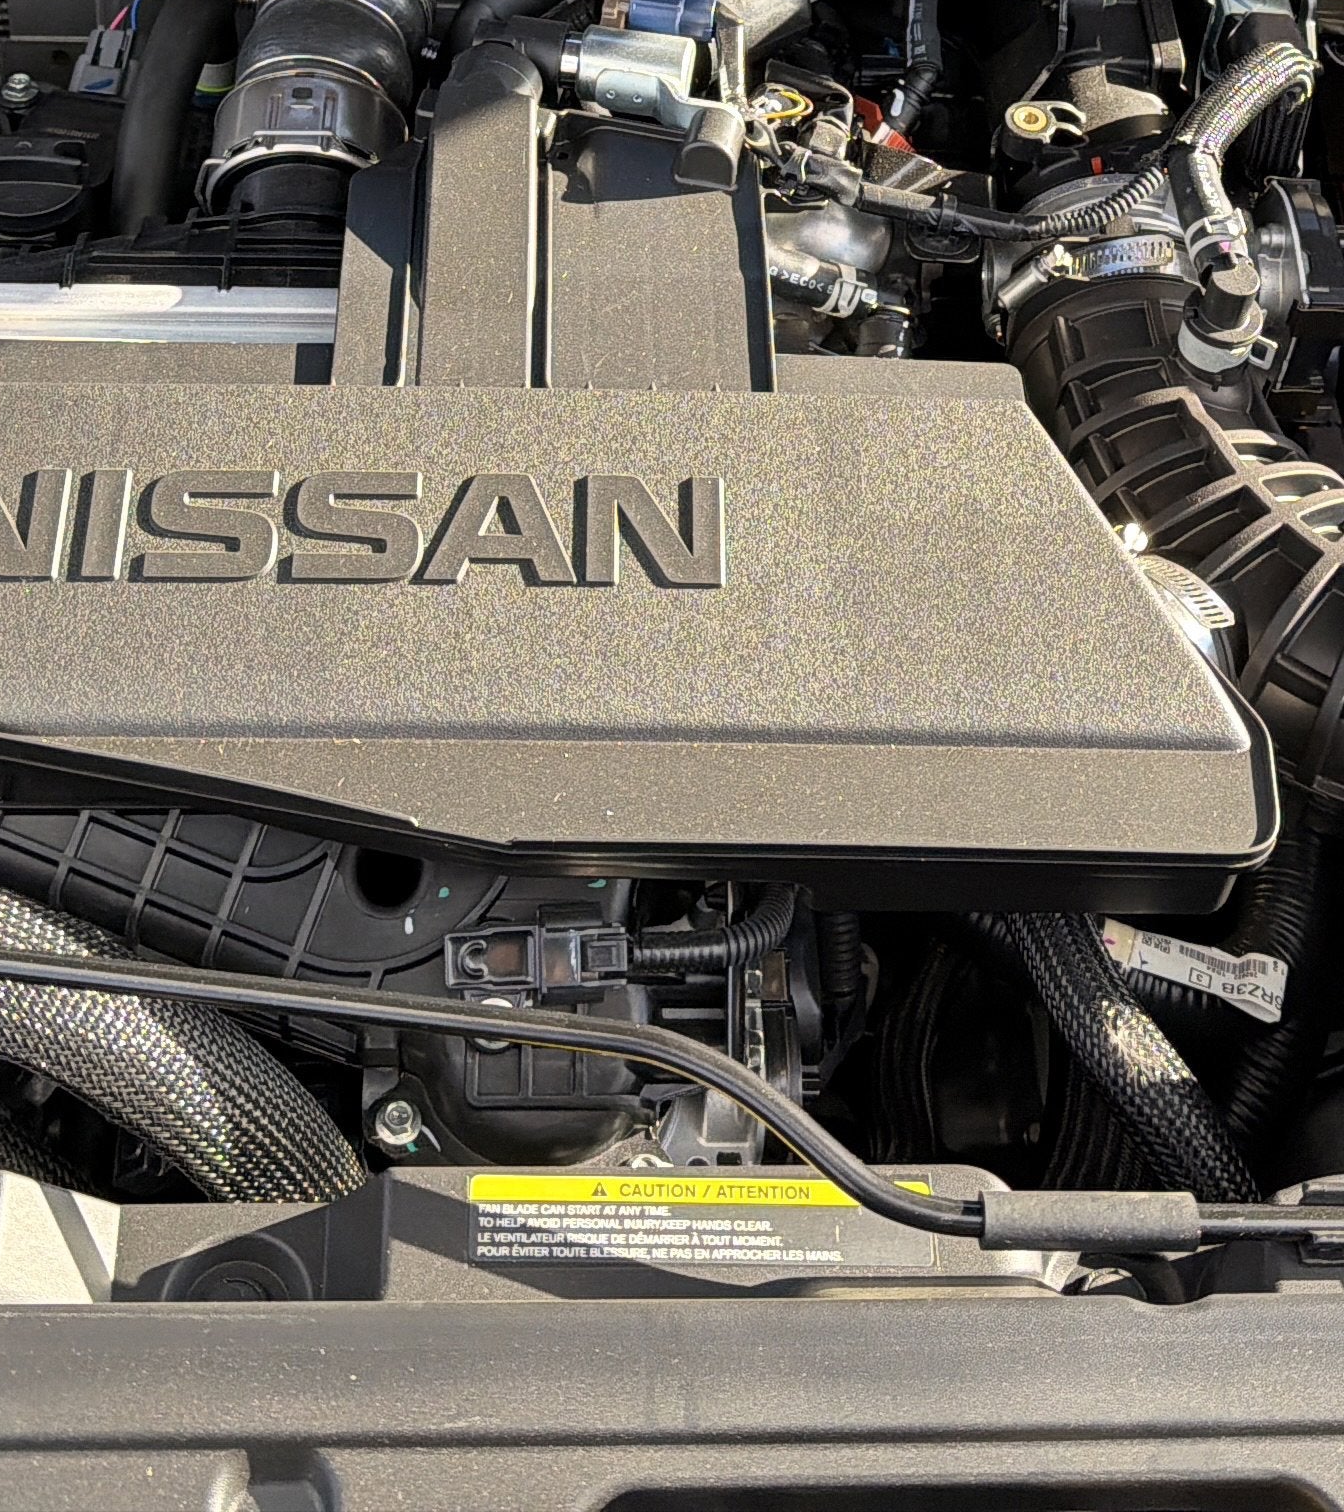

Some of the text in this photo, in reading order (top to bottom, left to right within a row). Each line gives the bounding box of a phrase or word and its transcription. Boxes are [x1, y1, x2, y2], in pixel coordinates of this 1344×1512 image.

[619, 1183, 695, 1198] CAUTION
[716, 1185, 810, 1199] ATTENTION
[478, 1204, 500, 1214] FAN
[502, 1204, 538, 1214] BLADE
[540, 1205, 565, 1215] CAN
[567, 1206, 601, 1215] START
[603, 1206, 617, 1215] AT
[618, 1206, 642, 1216] ANY
[478, 1217, 494, 1227] TO
[496, 1217, 525, 1228] HELP
[526, 1217, 560, 1228] AVOID
[563, 1218, 622, 1229] PERSONAL
[692, 1220, 732, 1231] HANDS
[734, 1220, 773, 1232] CLEAR.
[478, 1231, 784, 1247] LE VENTILATEUR RISQUE DE DÉMARRER À TOUT MOMENT.
[477, 1244, 844, 1262] POUR ÉVITER TOUTE BLESSURE, NE PAS EN APPROCHER LES MAINS.
